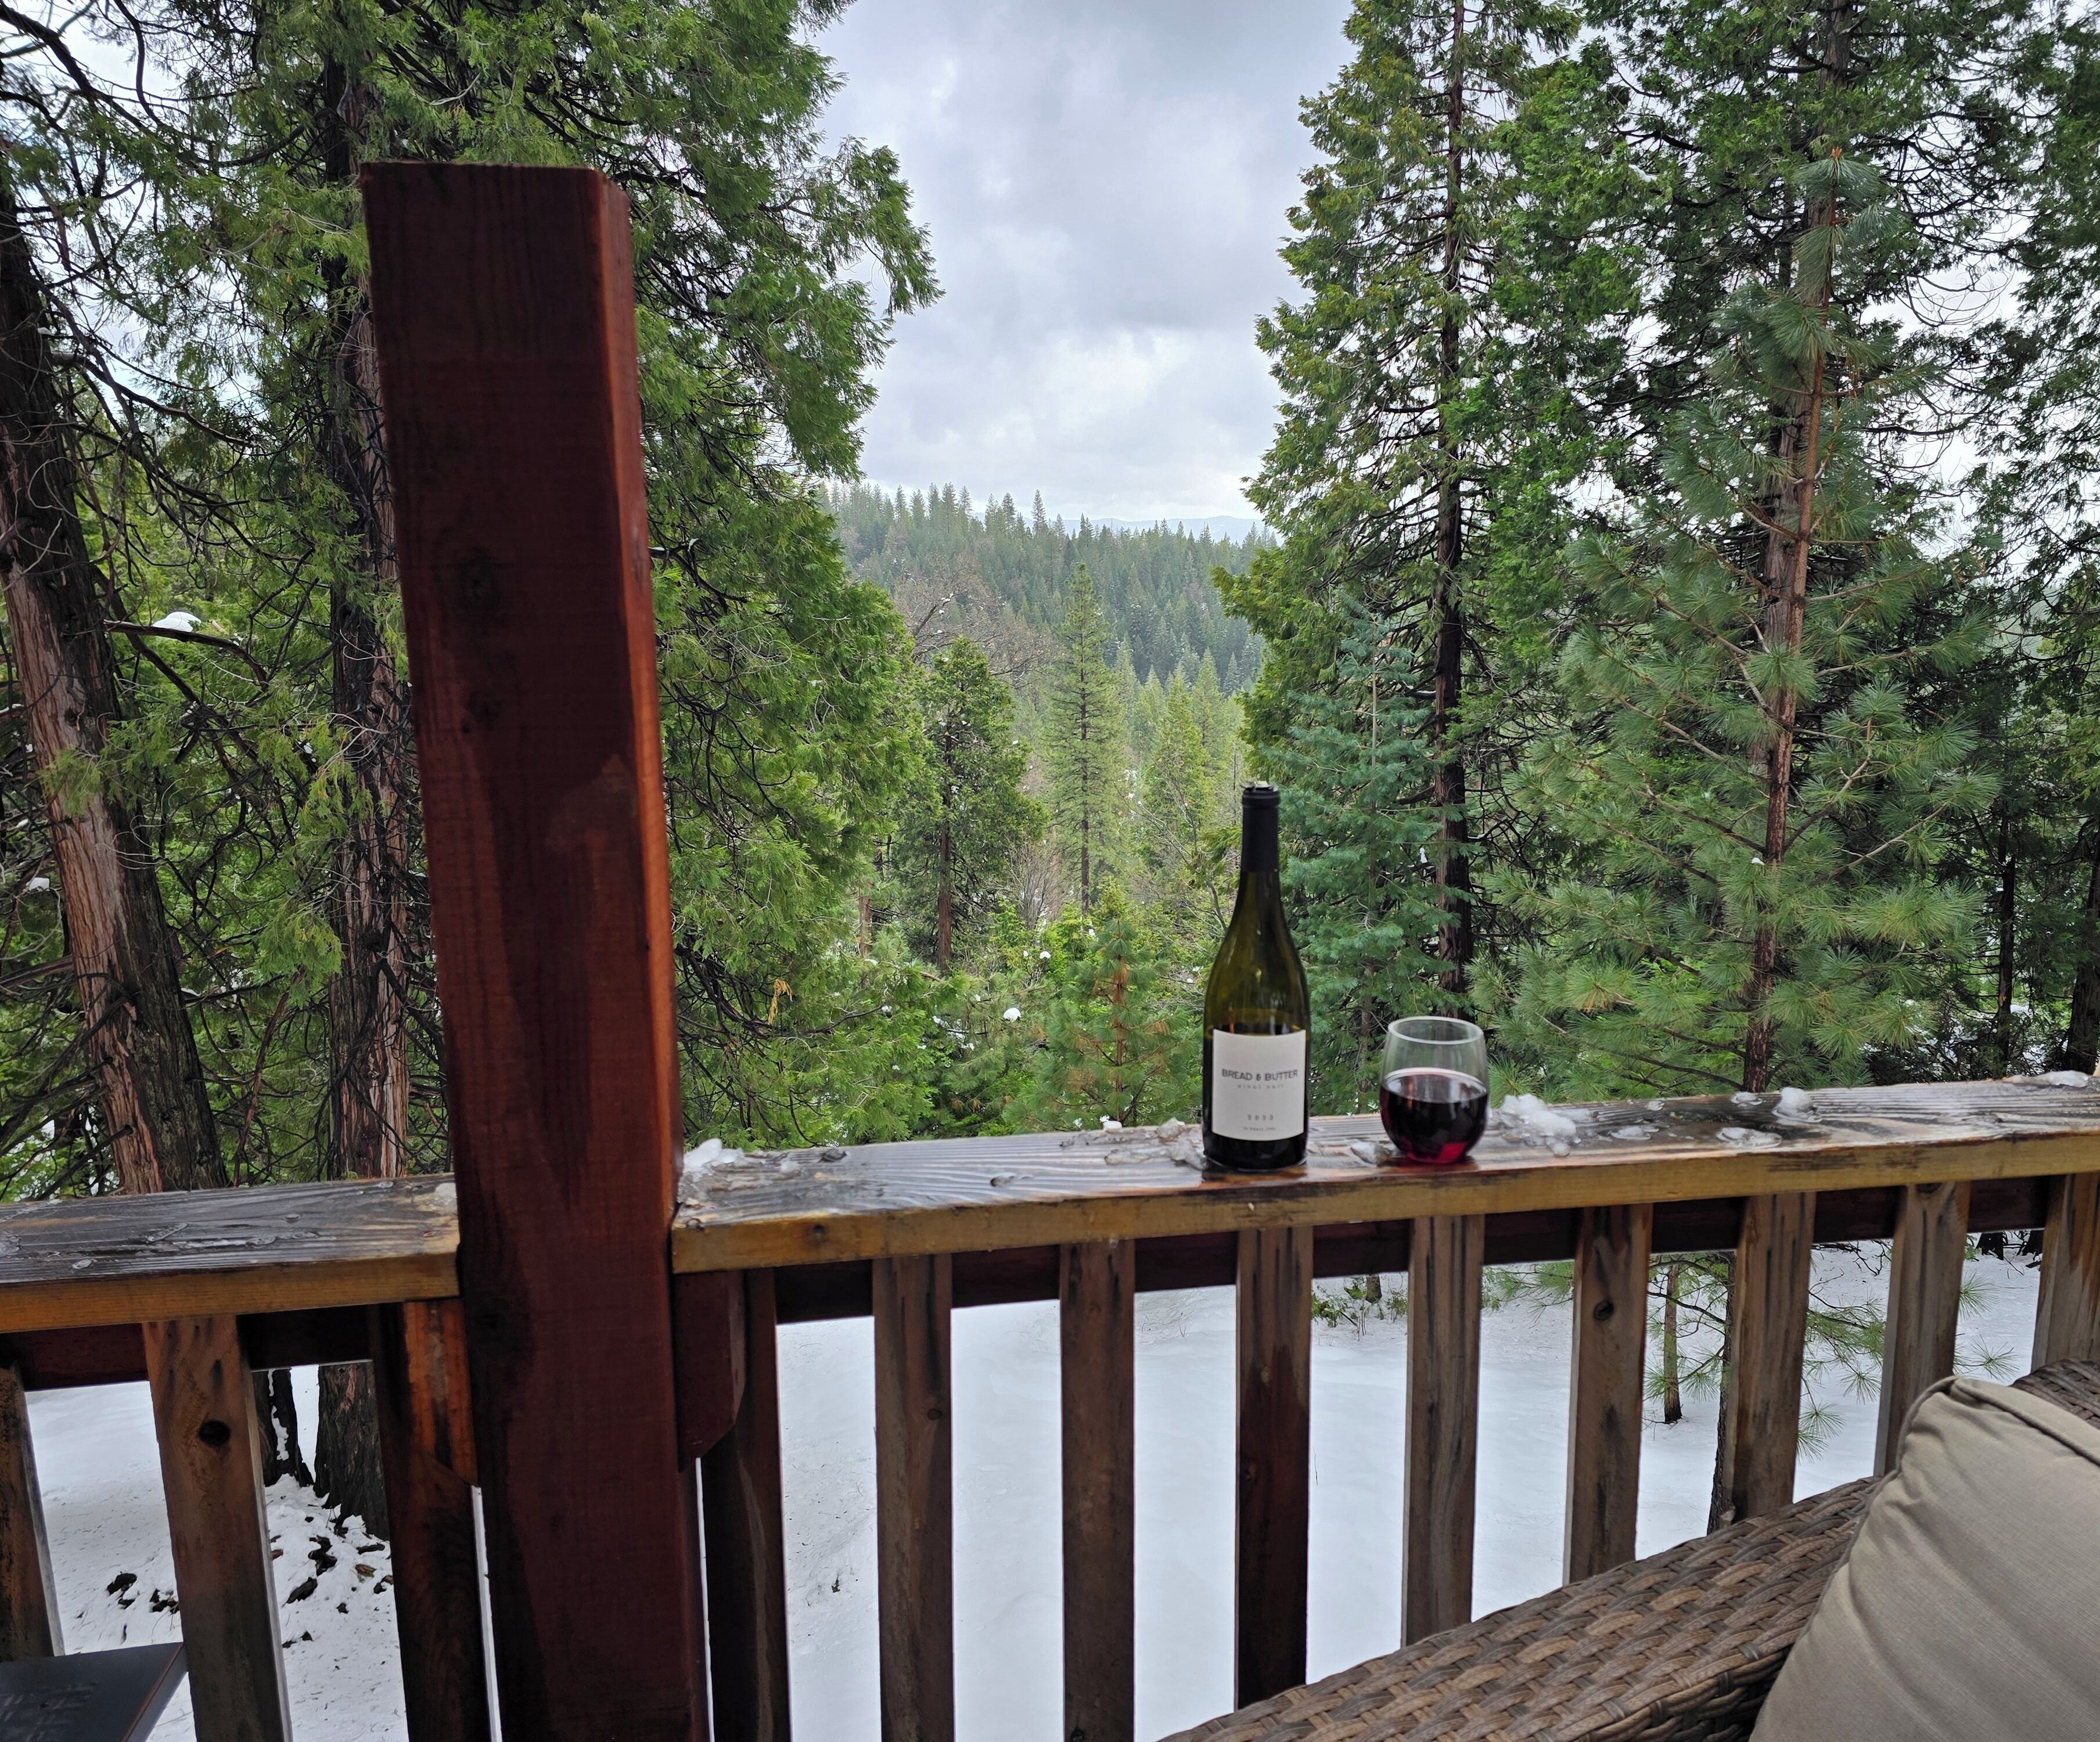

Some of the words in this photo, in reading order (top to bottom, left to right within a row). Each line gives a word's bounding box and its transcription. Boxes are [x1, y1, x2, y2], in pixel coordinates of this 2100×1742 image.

[1222, 1068, 1253, 1081] BREAD
[1256, 1073, 1261, 1081] &
[1265, 1070, 1298, 1081] BUTTER
